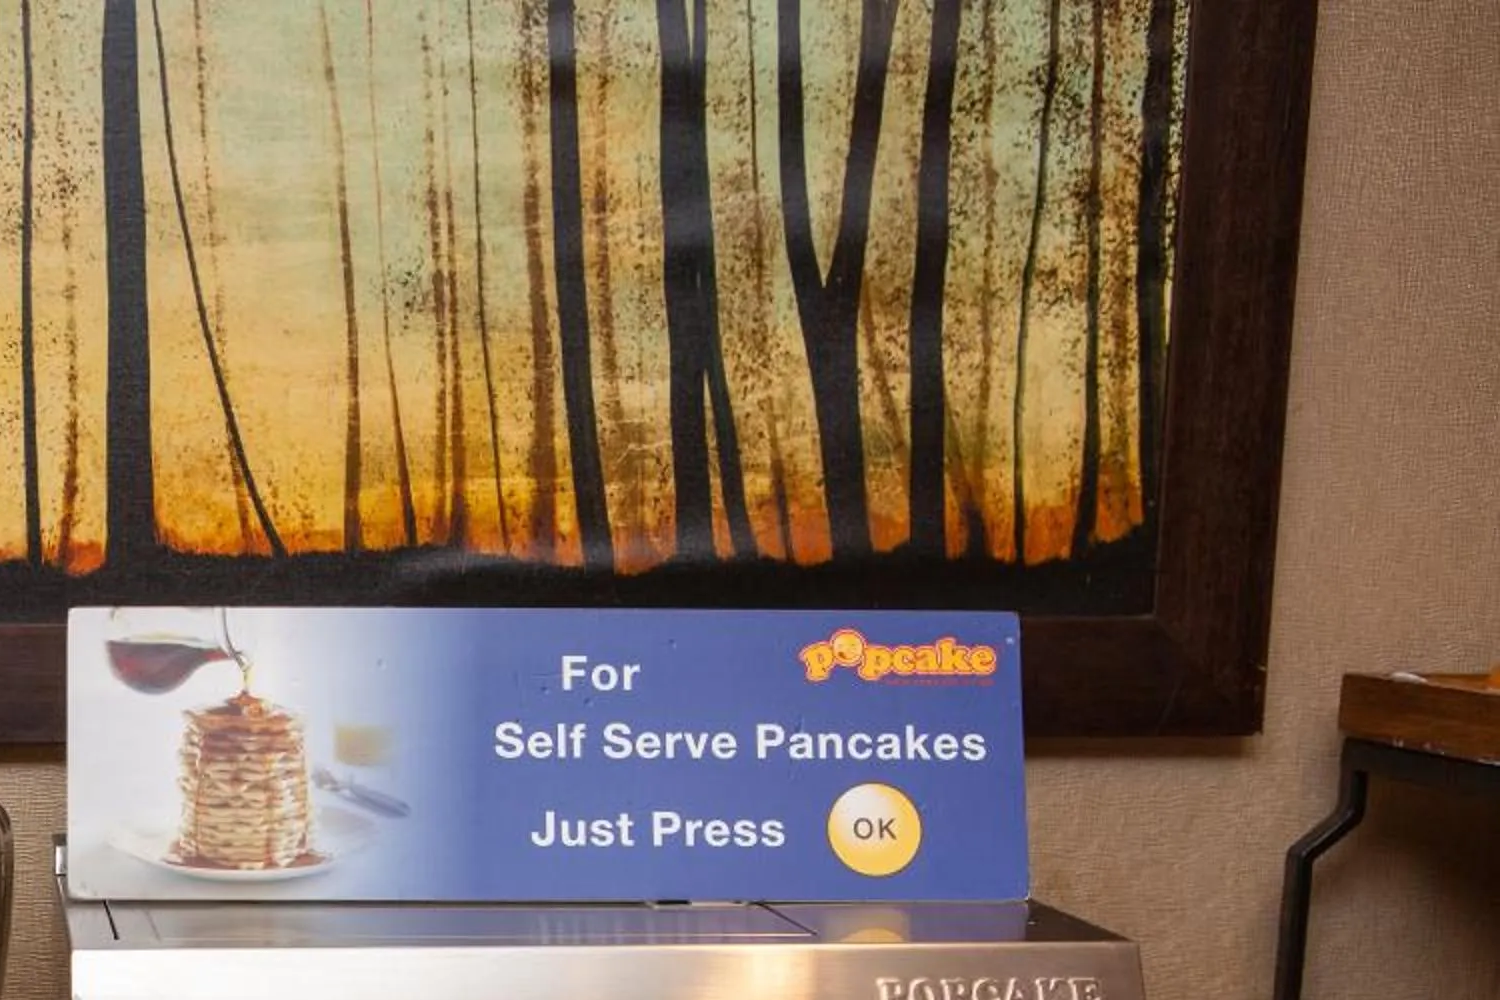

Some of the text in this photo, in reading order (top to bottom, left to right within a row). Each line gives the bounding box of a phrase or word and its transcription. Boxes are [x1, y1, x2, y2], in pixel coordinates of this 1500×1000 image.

[561, 654, 641, 691] For
[494, 721, 988, 761] Self Serve Pancakes
[530, 810, 786, 848] Just Press
[853, 817, 897, 841] OK
